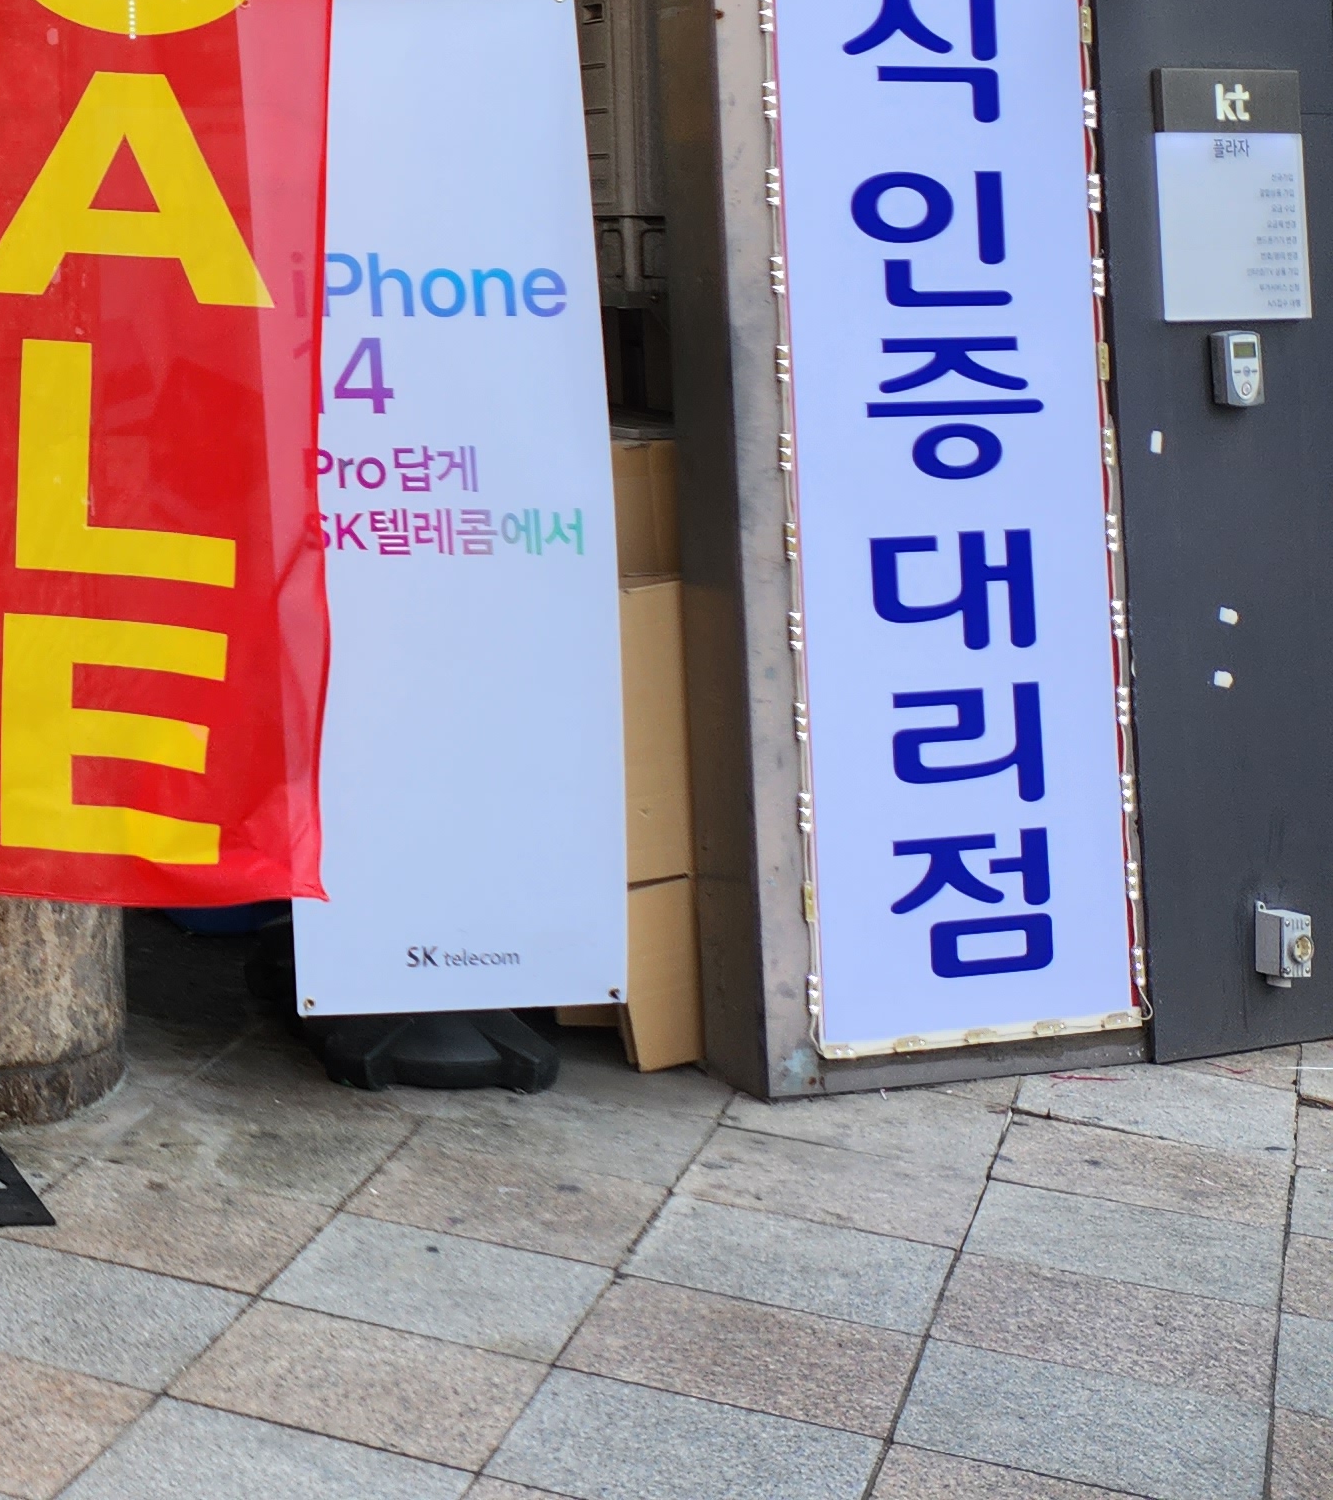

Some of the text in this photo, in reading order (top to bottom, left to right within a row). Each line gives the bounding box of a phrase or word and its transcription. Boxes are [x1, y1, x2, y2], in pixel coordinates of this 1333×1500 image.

[1214, 84, 1251, 122] kt
[1212, 138, 1250, 158] 플라자
[850, 170, 1045, 481] 인증
[869, 528, 1054, 979] 대리점
[405, 946, 521, 967] SK telecom
